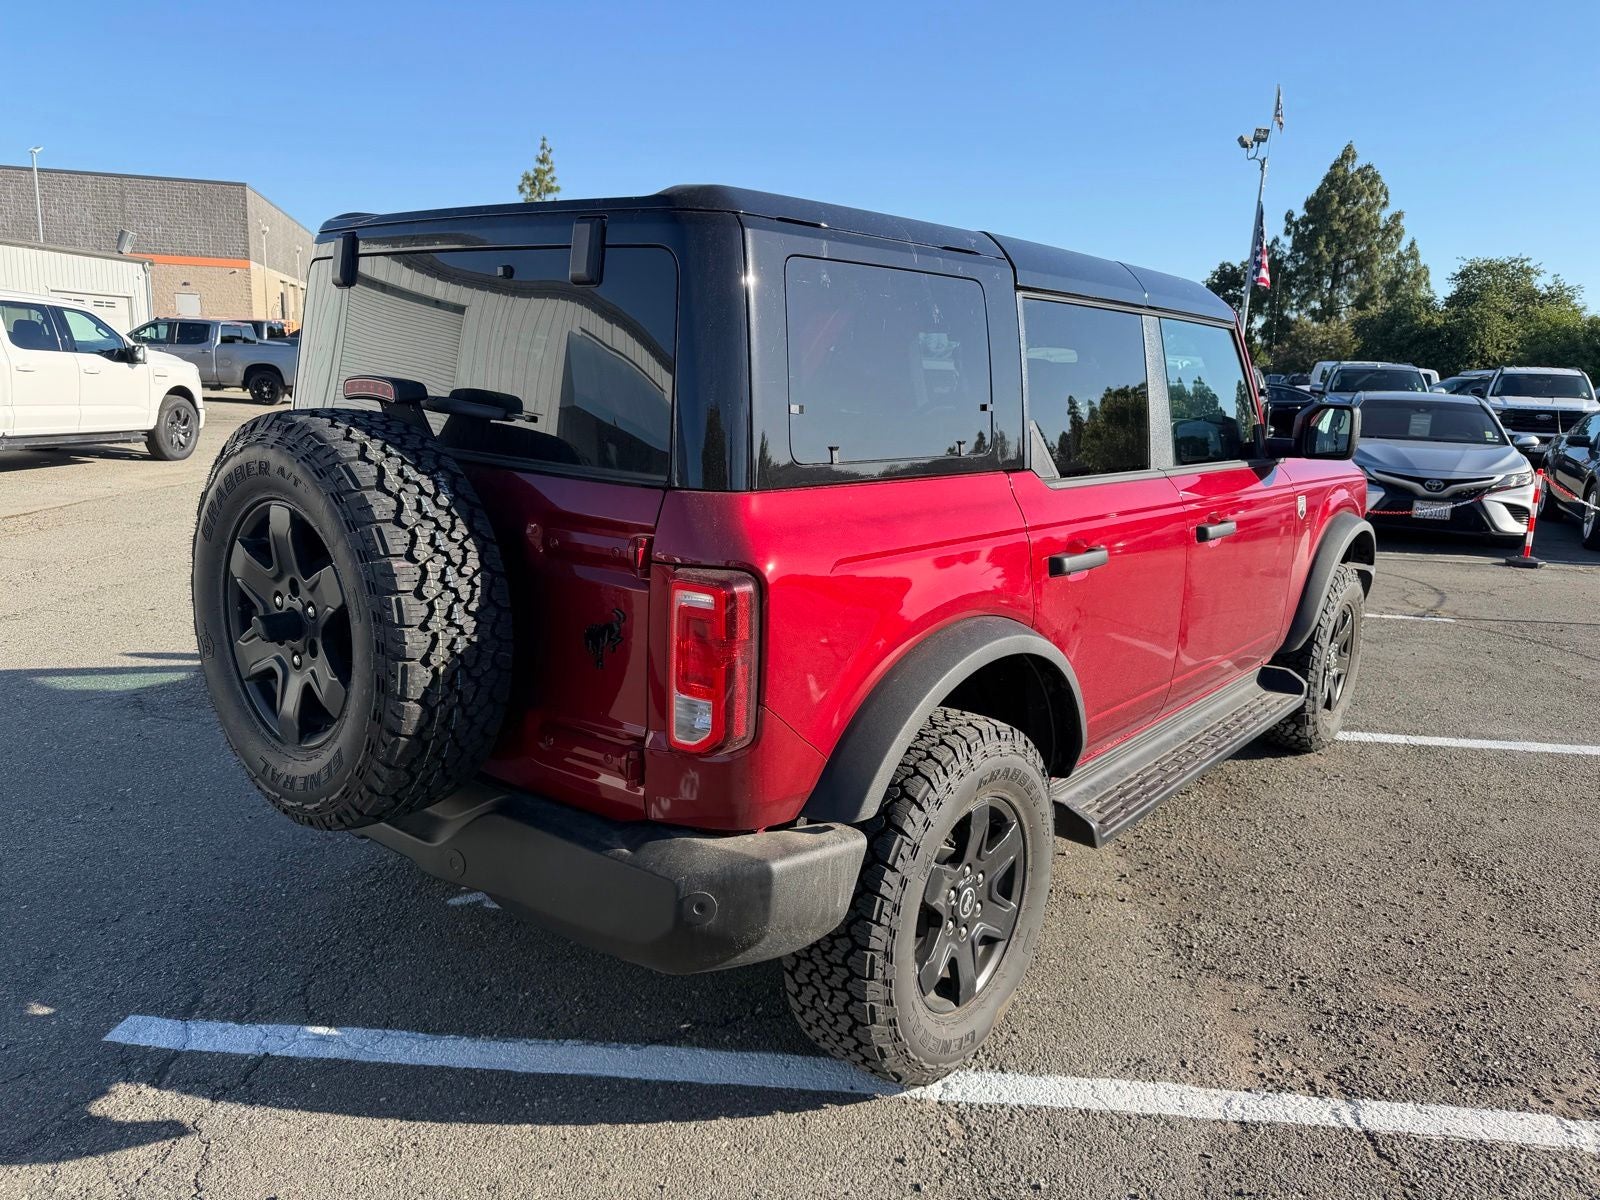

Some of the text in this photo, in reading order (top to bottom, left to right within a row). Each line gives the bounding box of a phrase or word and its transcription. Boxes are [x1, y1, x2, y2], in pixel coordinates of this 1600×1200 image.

[201, 460, 272, 542] GRABBER
[257, 747, 344, 793] GENERAL
[976, 767, 1042, 808] GRABBER
[907, 1001, 976, 1056] GENERAL
